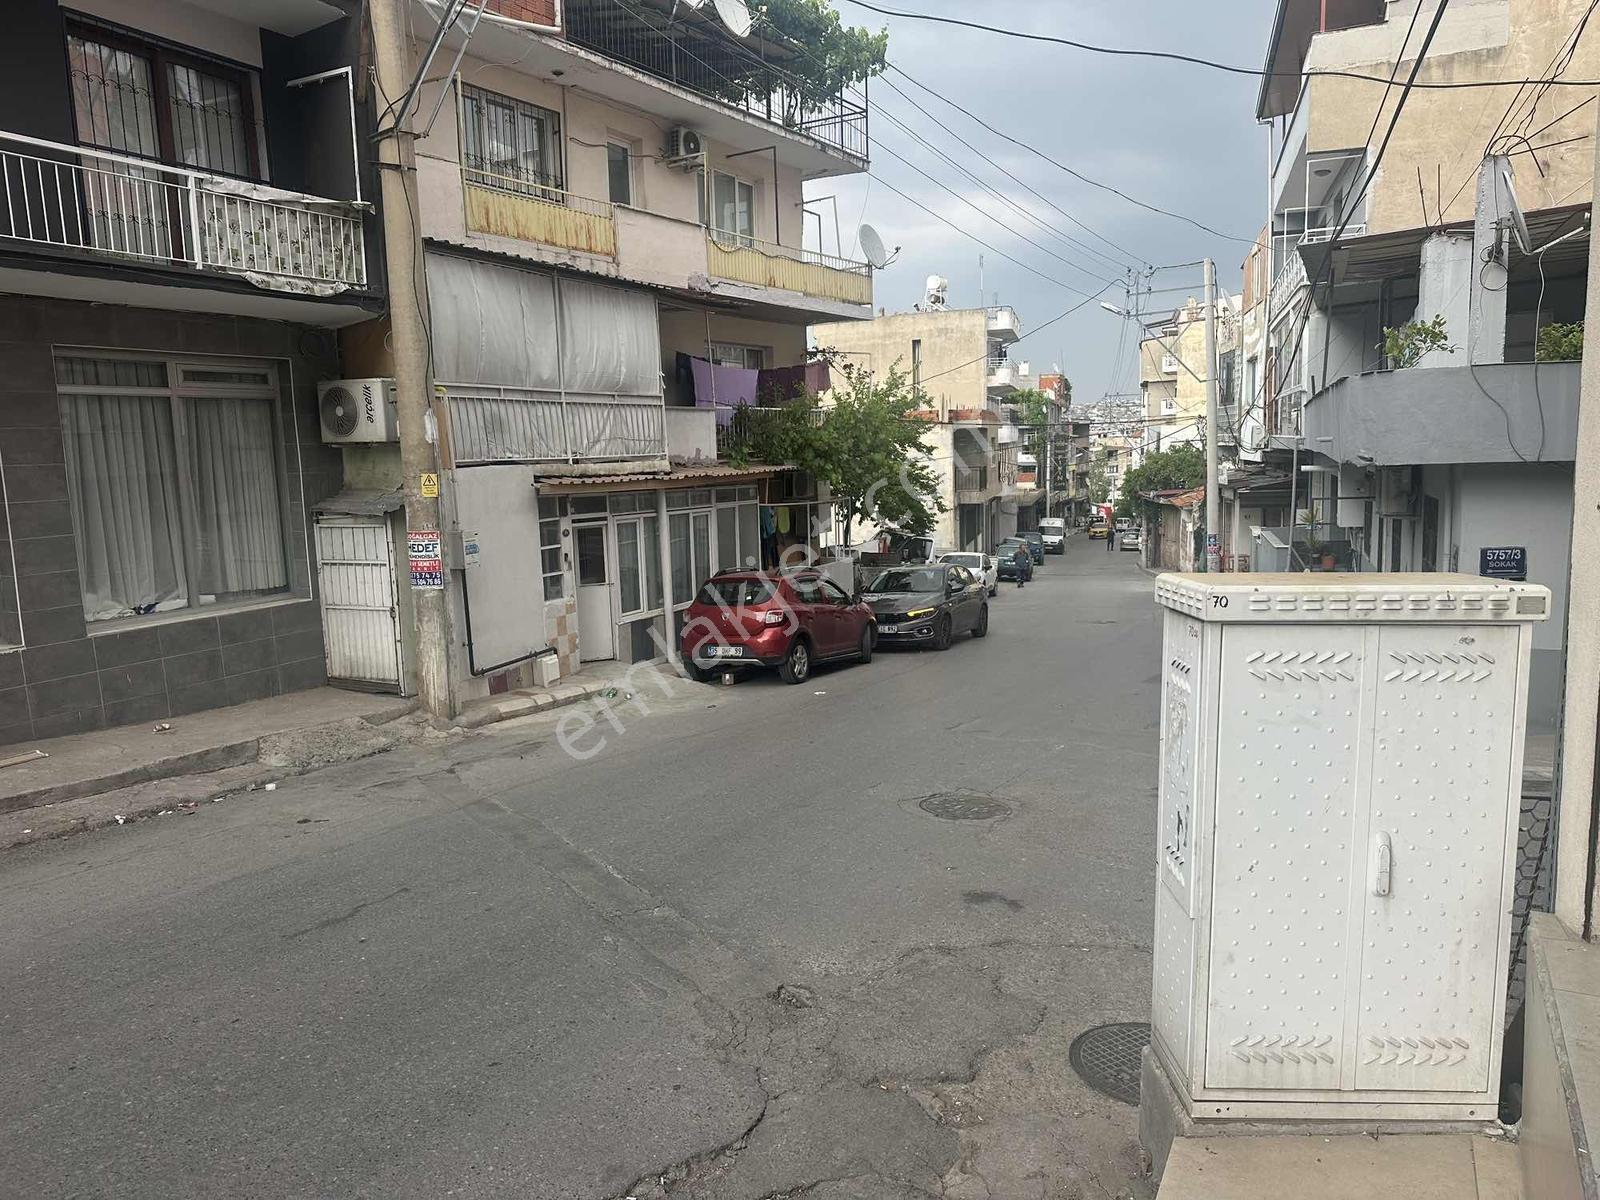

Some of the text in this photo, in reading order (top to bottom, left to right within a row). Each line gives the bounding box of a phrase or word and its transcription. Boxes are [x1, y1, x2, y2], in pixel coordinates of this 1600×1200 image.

[362, 384, 375, 424] arçelik
[1486, 549, 1521, 560] 5757/3
[1488, 560, 1517, 568] SOKAK
[1212, 595, 1229, 609] 70
